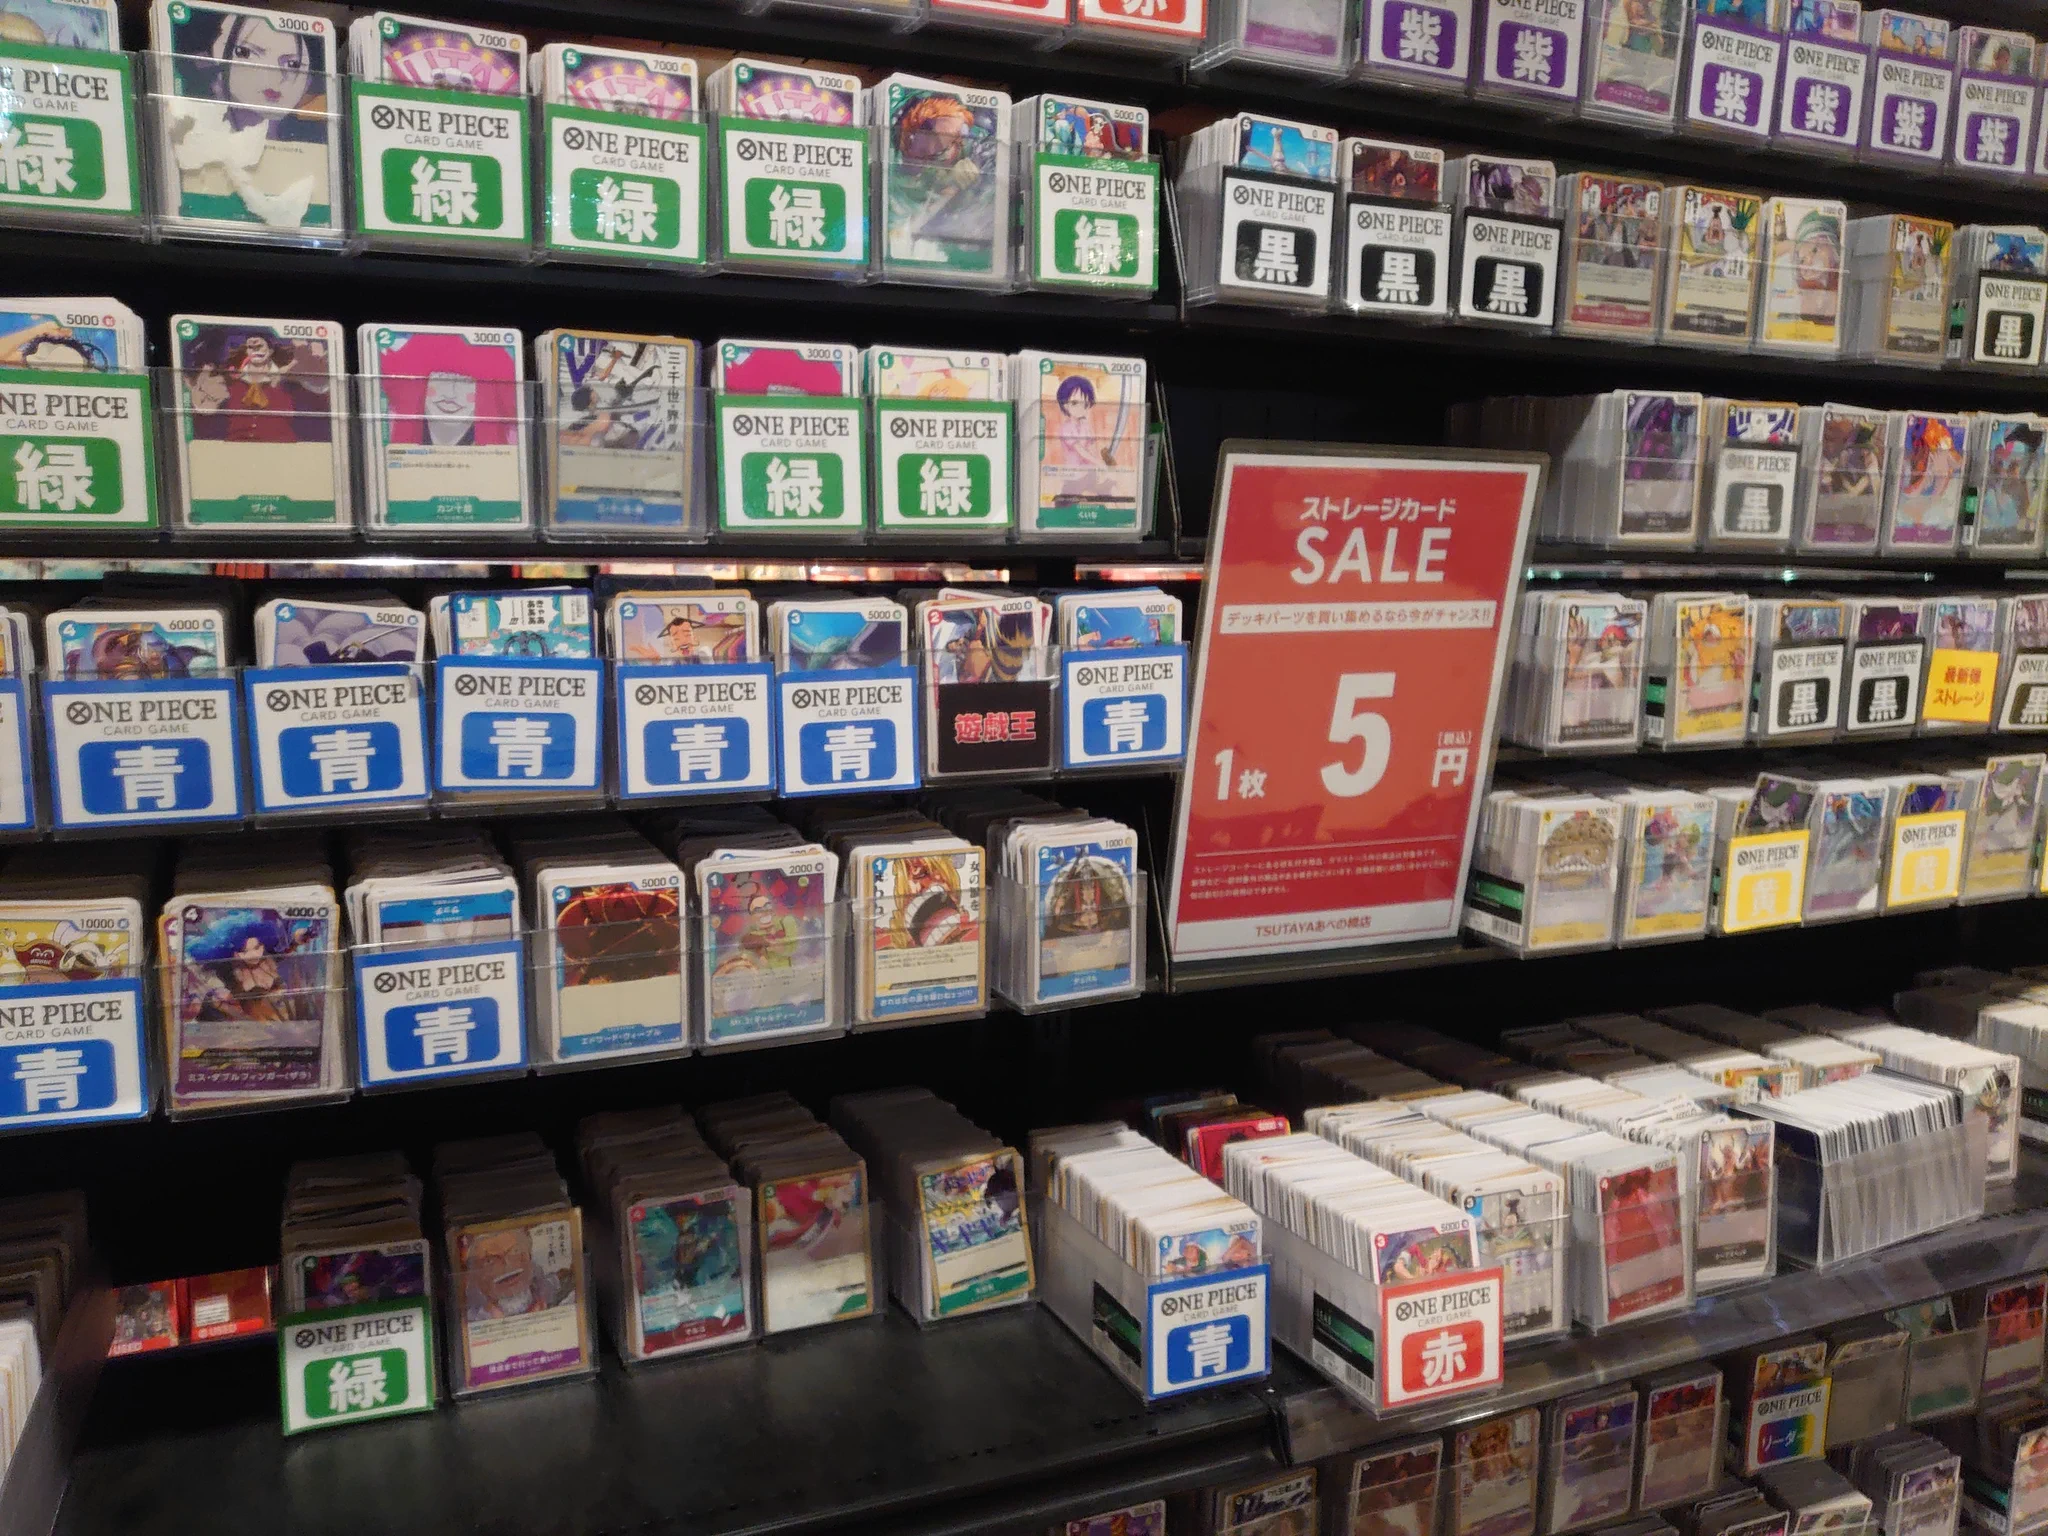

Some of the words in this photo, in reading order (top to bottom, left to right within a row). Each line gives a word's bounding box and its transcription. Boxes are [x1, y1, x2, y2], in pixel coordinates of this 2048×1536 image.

[278, 17, 309, 32] 3000
[1399, 7, 1442, 65] 紫
[478, 33, 507, 48] 7000
[1702, 31, 1732, 52] ONE
[1736, 40, 1772, 62] PIECE
[653, 59, 679, 72] 7000
[1512, 29, 1554, 85] 紫
[1826, 54, 1859, 73] PIECE
[24, 69, 109, 100] PIECE
[818, 75, 843, 88] 7000
[33, 98, 78, 112] GAME
[966, 93, 988, 105] 3000
[1714, 72, 1748, 120] 紫
[1806, 85, 1838, 132] 紫
[372, 106, 430, 131] ONE
[440, 113, 508, 138] PIECE
[1113, 109, 1135, 120] 5000
[1894, 102, 1924, 145] 紫
[404, 130, 441, 146] CARD
[445, 134, 482, 149] GAME
[564, 128, 617, 153] ONE
[626, 136, 688, 162] PIECE
[1977, 118, 2007, 160] 紫
[0, 121, 78, 194] 緑
[737, 139, 786, 161] ONE
[795, 144, 852, 166] PIECE
[412, 158, 476, 222] 緑
[1049, 173, 1090, 194] ONE
[1097, 178, 1144, 199] PIECE
[597, 178, 656, 240] 緑
[1234, 186, 1273, 207] ONE
[1278, 193, 1324, 214] PIECE
[770, 186, 824, 244] 緑
[1358, 211, 1394, 230] ONE
[1399, 216, 1442, 235] PIECE
[1075, 217, 1121, 271] 緑
[1473, 224, 1507, 243] ONE
[1512, 230, 1551, 250] PIECE
[1254, 229, 1297, 281] 黒
[1378, 252, 1418, 301] 黒
[1489, 264, 1526, 312] 黒
[2012, 286, 2040, 301] PIECE
[66, 314, 99, 326] 5000
[283, 325, 313, 337] 5000
[472, 332, 500, 343] 3000
[807, 348, 831, 359] 3000
[1110, 363, 1131, 372] 2000
[44, 393, 129, 419] PIECE
[5, 418, 48, 430] CARD
[54, 420, 99, 432] GAME
[734, 415, 783, 435] ONE
[791, 417, 848, 436] PIECE
[891, 418, 936, 437] ONE
[943, 420, 996, 438] PIECE
[915, 437, 944, 448] CARD
[947, 438, 976, 449] GAME
[14, 440, 96, 511] 緑
[767, 458, 822, 515] 緑
[920, 460, 970, 514] 緑
[1300, 496, 1456, 521] ストレージカード
[1290, 526, 1452, 584] SALE
[375, 612, 404, 625] 5000
[868, 610, 891, 619] 5000
[1001, 602, 1023, 612] 4000
[1145, 603, 1165, 613] 6000
[169, 618, 200, 630] 6000
[1887, 648, 1918, 666] PIECE
[456, 675, 511, 696] ONE
[520, 677, 585, 696] PIECE
[1077, 667, 1118, 685] ONE
[1124, 664, 1172, 681] PIECE
[267, 689, 326, 711] ONE
[335, 684, 404, 706] PIECE
[486, 695, 521, 706] CARD
[526, 696, 560, 707] GAME
[636, 685, 687, 705] ONE
[696, 683, 755, 702] PIECE
[792, 689, 839, 708] ONE
[846, 684, 903, 705] PIECE
[1869, 680, 1896, 720] 黒
[1933, 688, 1985, 708] ストレージ
[67, 702, 131, 724] ONE
[140, 698, 218, 722] PIECE
[300, 708, 338, 721] CARD
[342, 705, 380, 718] GAME
[102, 723, 143, 736] CARD
[148, 722, 189, 735] GAME
[955, 711, 1036, 743] 遊戯王
[1103, 699, 1150, 753] 青
[1320, 672, 1396, 797] 5
[1431, 748, 1468, 787] 円
[490, 718, 550, 774] 青
[672, 724, 726, 779] 青
[825, 726, 874, 779] 青
[311, 730, 373, 790] 青
[114, 746, 181, 808] 青
[1105, 839, 1124, 848] 1000
[1928, 825, 1955, 839] PIECE
[1767, 846, 1797, 861] PIECE
[789, 864, 813, 874] 2000
[641, 877, 667, 888] 5000
[80, 918, 114, 929] 10000
[286, 907, 315, 918] 4000
[375, 970, 430, 993] ONE
[439, 962, 504, 985] PIECE
[43, 1000, 123, 1026] PIECE
[5, 1029, 45, 1041] CARD
[51, 1025, 93, 1038] GAME
[415, 1007, 474, 1063] 青
[14, 1048, 88, 1112] 青
[1162, 1294, 1202, 1315] ONE
[1209, 1283, 1256, 1306] PIECE
[1395, 1297, 1437, 1321] ONE
[1441, 1286, 1491, 1312] PIECE
[295, 1325, 346, 1348] ONE
[354, 1315, 412, 1338] PIECE
[1188, 1325, 1231, 1376] 青
[1421, 1329, 1466, 1384] 赤
[330, 1358, 385, 1410] 緑
